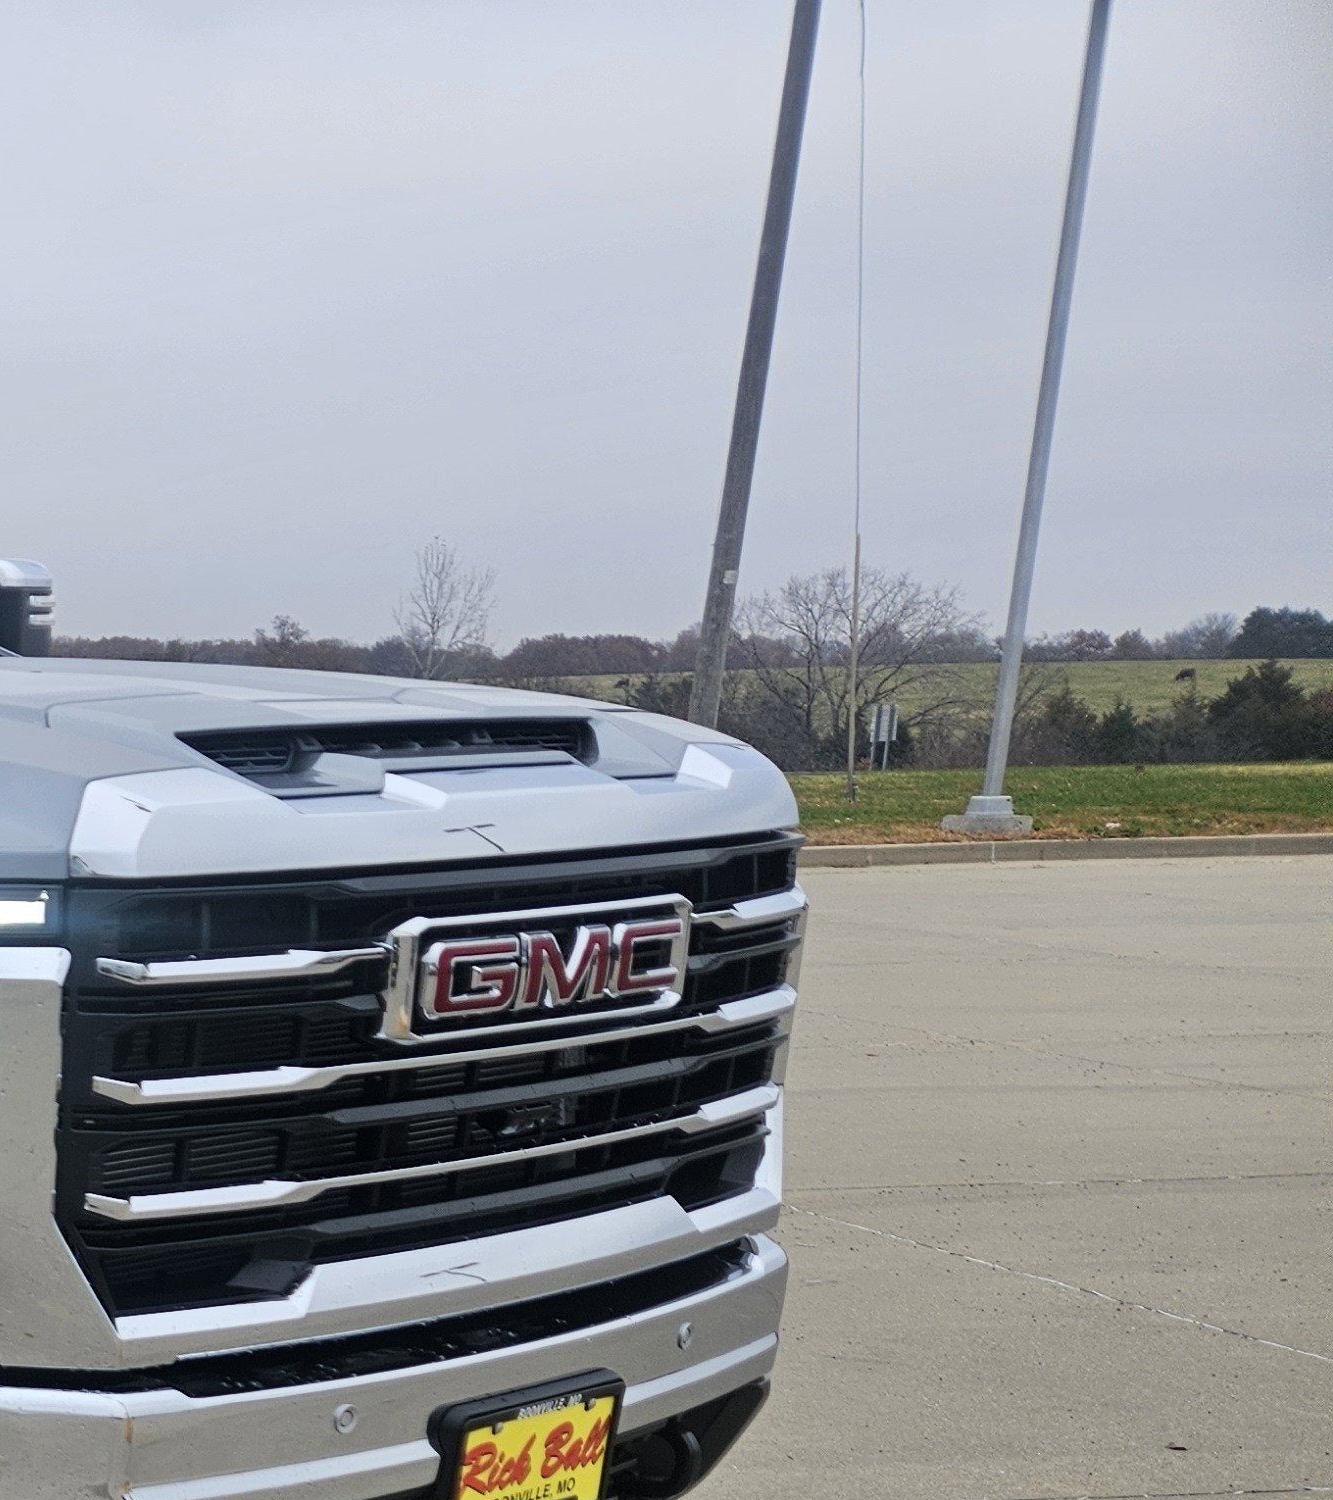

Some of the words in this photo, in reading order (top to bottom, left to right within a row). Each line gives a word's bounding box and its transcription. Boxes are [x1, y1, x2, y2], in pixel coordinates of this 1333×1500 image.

[421, 918, 683, 1020] GMC
[461, 1432, 537, 1496] Rick
[540, 1413, 612, 1479] Ball
[556, 1476, 576, 1494] MO
